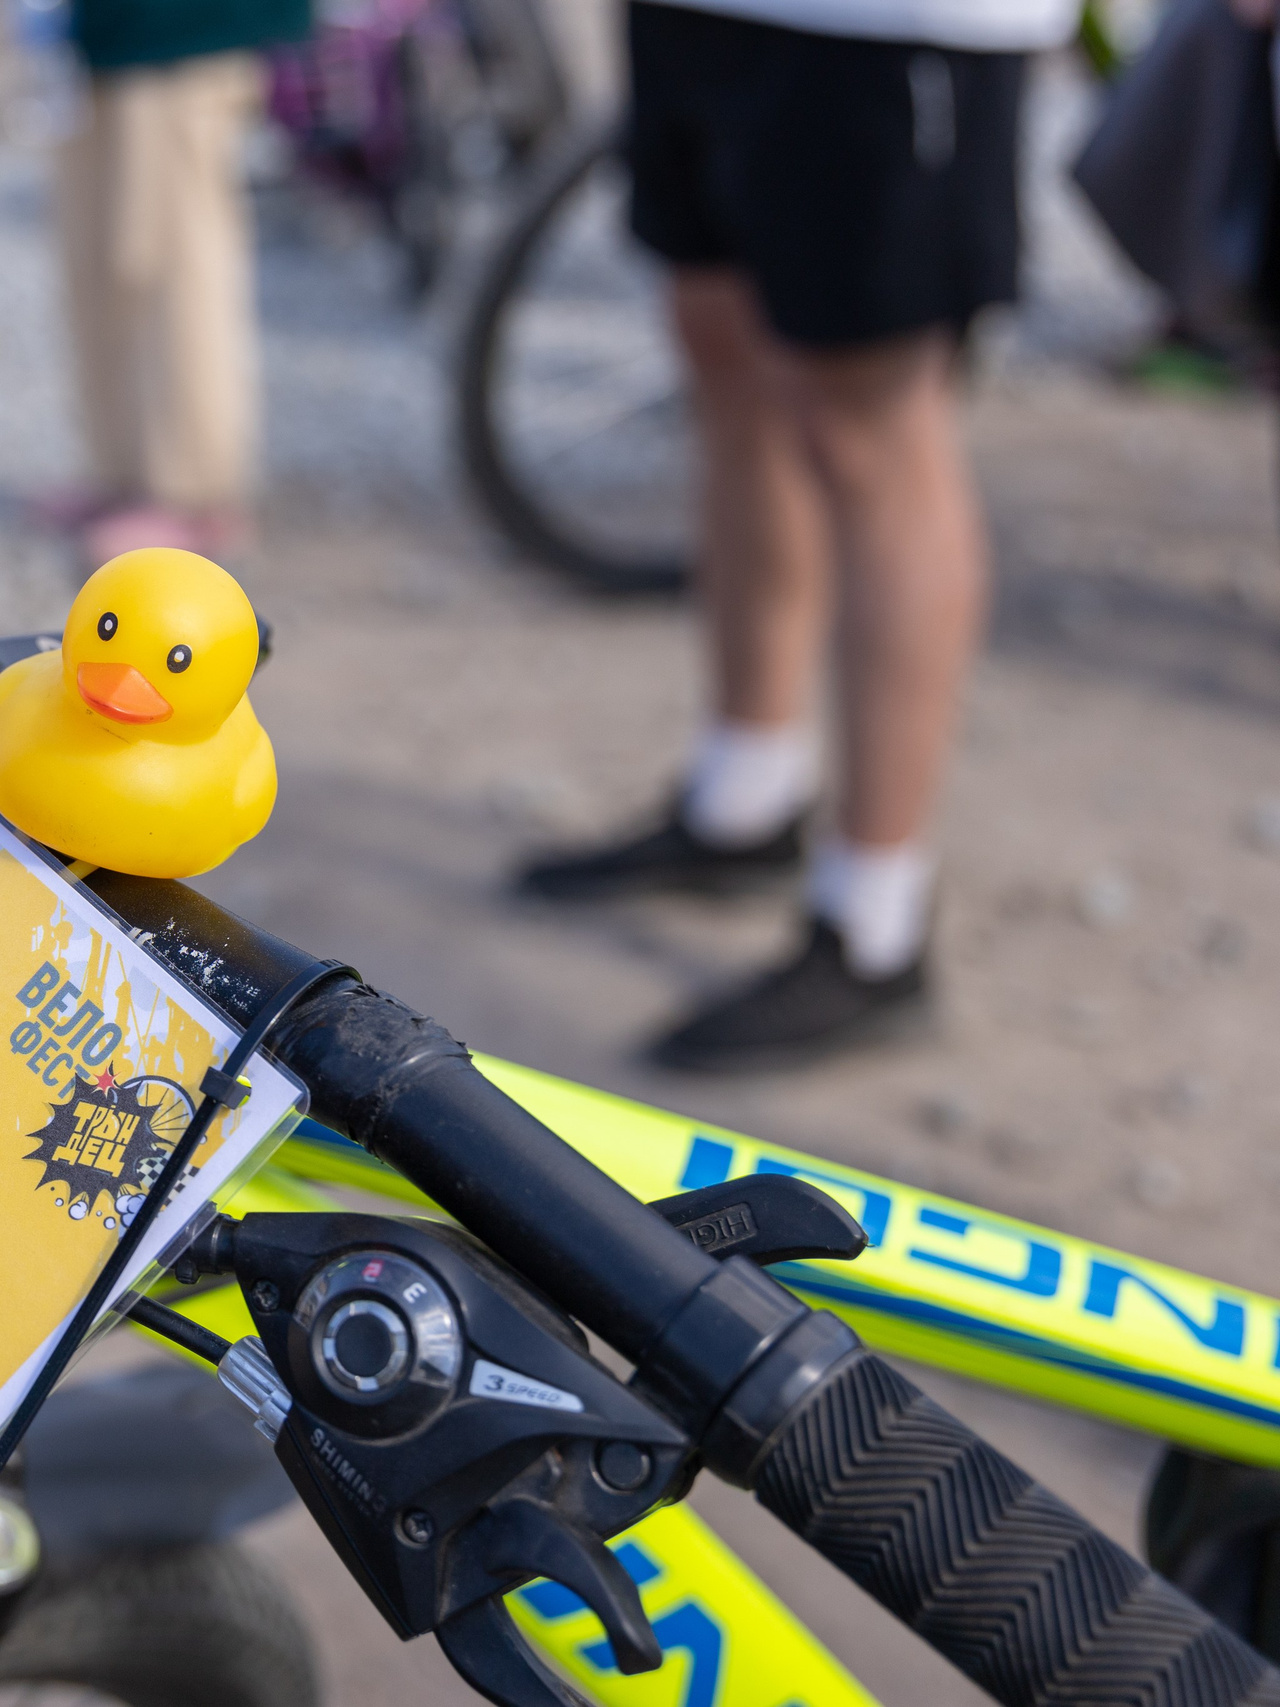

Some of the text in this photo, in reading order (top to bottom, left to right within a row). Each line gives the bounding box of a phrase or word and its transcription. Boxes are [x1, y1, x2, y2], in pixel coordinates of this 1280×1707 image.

[16, 961, 122, 1067] ВЕЛО
[9, 1021, 91, 1099] ФЕСТ
[483, 1374, 561, 1402] 3 SPEED
